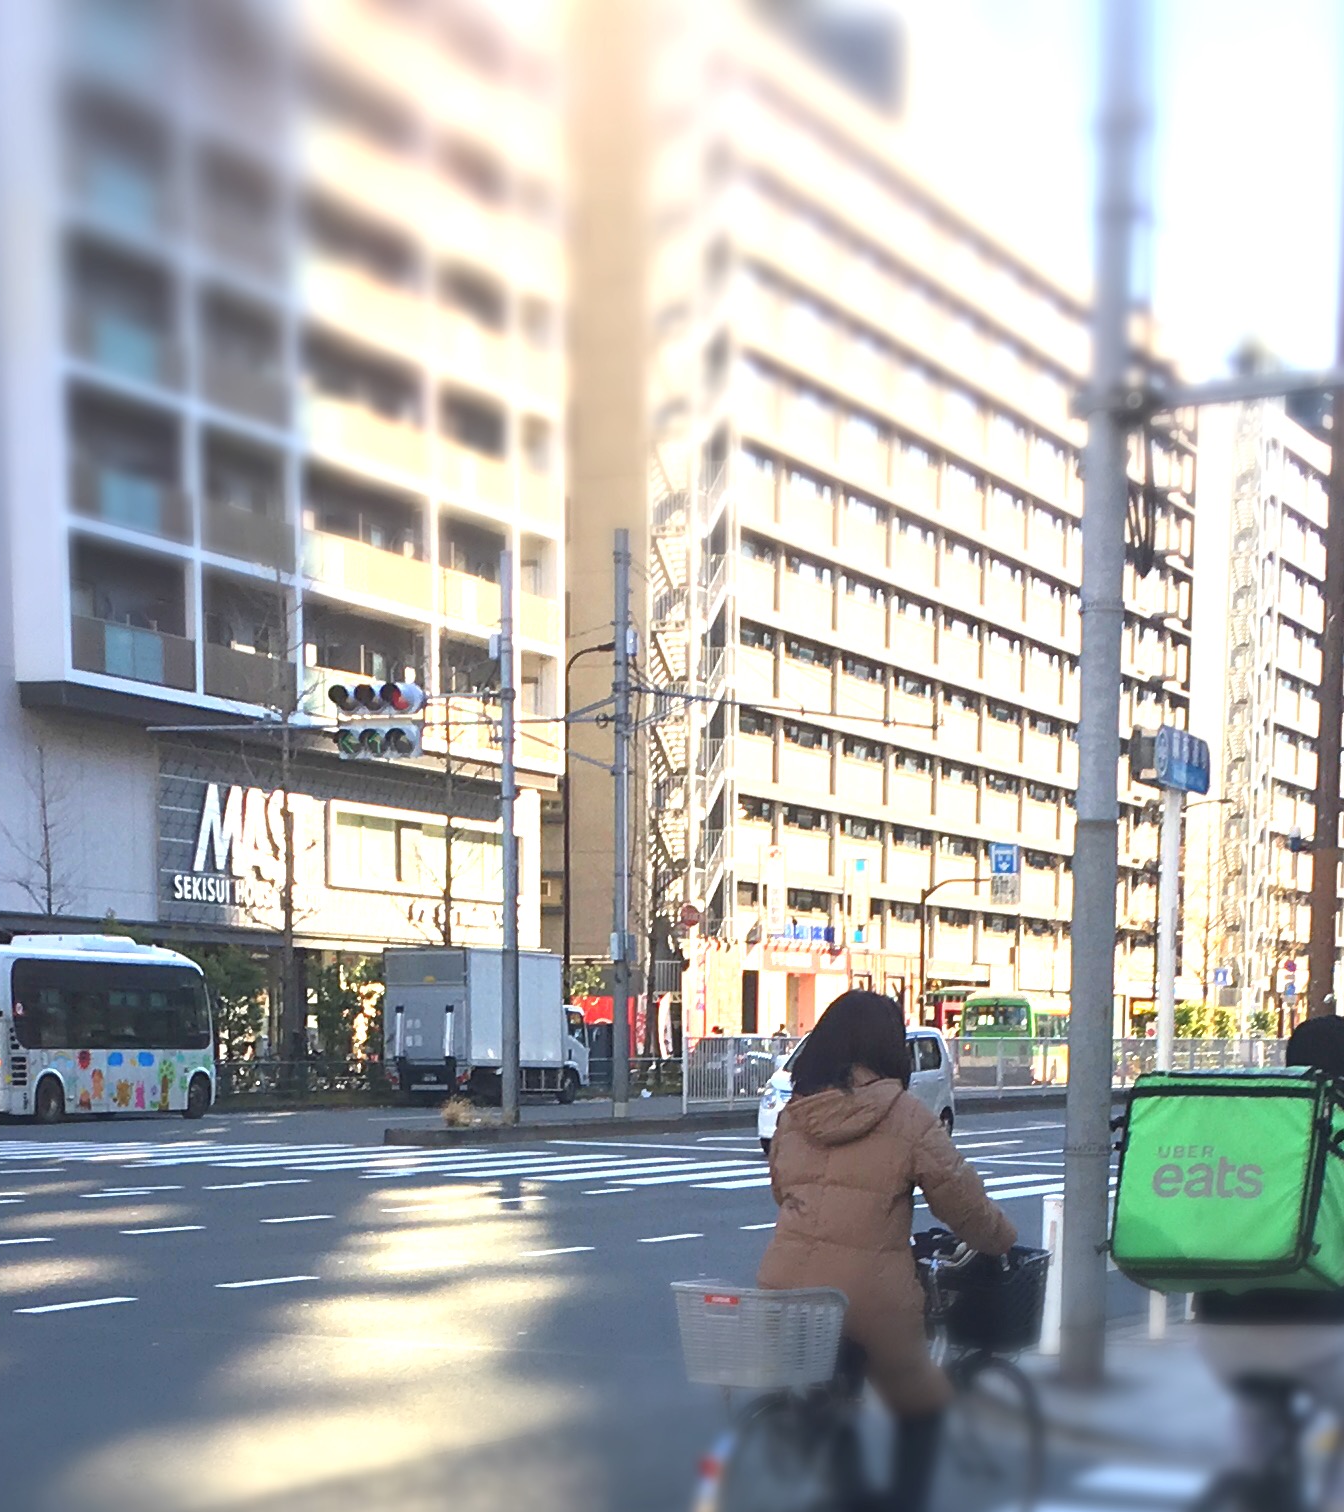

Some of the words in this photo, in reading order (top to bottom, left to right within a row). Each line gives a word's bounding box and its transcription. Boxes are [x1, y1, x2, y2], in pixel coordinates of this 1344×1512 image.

[174, 875, 230, 903] SEKISUI
[1157, 1145, 1216, 1159] UBER
[1152, 1156, 1264, 1199] eats
